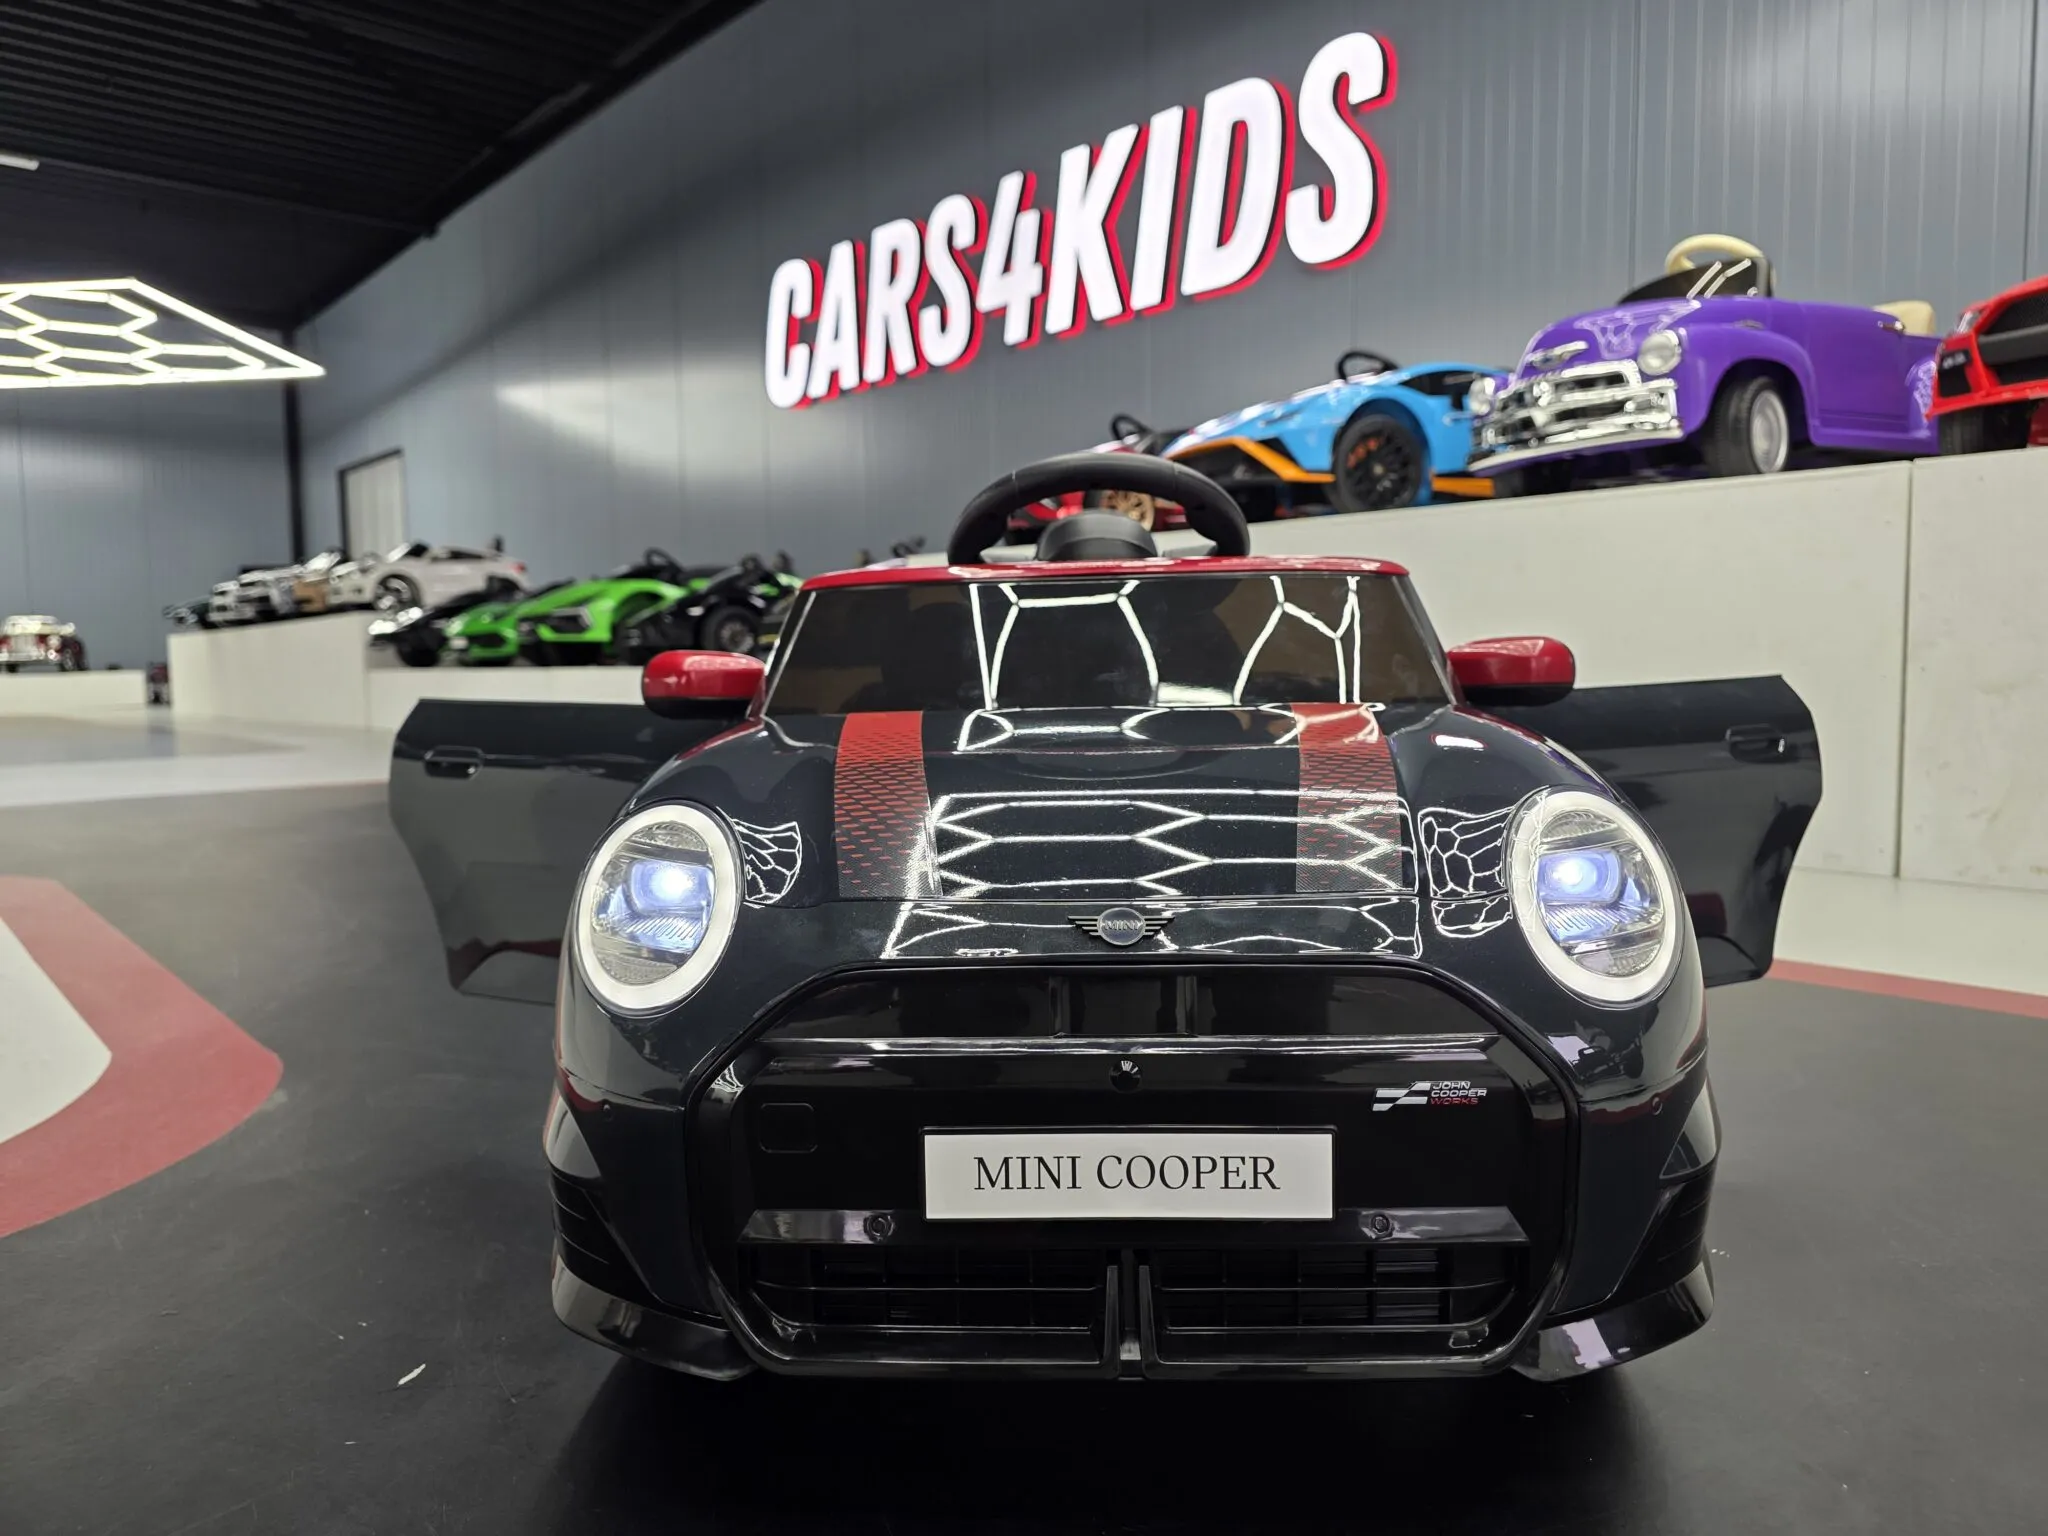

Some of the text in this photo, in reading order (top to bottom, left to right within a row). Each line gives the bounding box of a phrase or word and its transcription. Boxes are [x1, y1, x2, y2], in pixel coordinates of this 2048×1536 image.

[765, 31, 1393, 409] CARS4KIDS
[1104, 919, 1141, 931] MINI
[1432, 1081, 1471, 1089] JOHN
[1431, 1089, 1487, 1097] COOPER
[973, 1155, 1281, 1190] MINI COOPER
